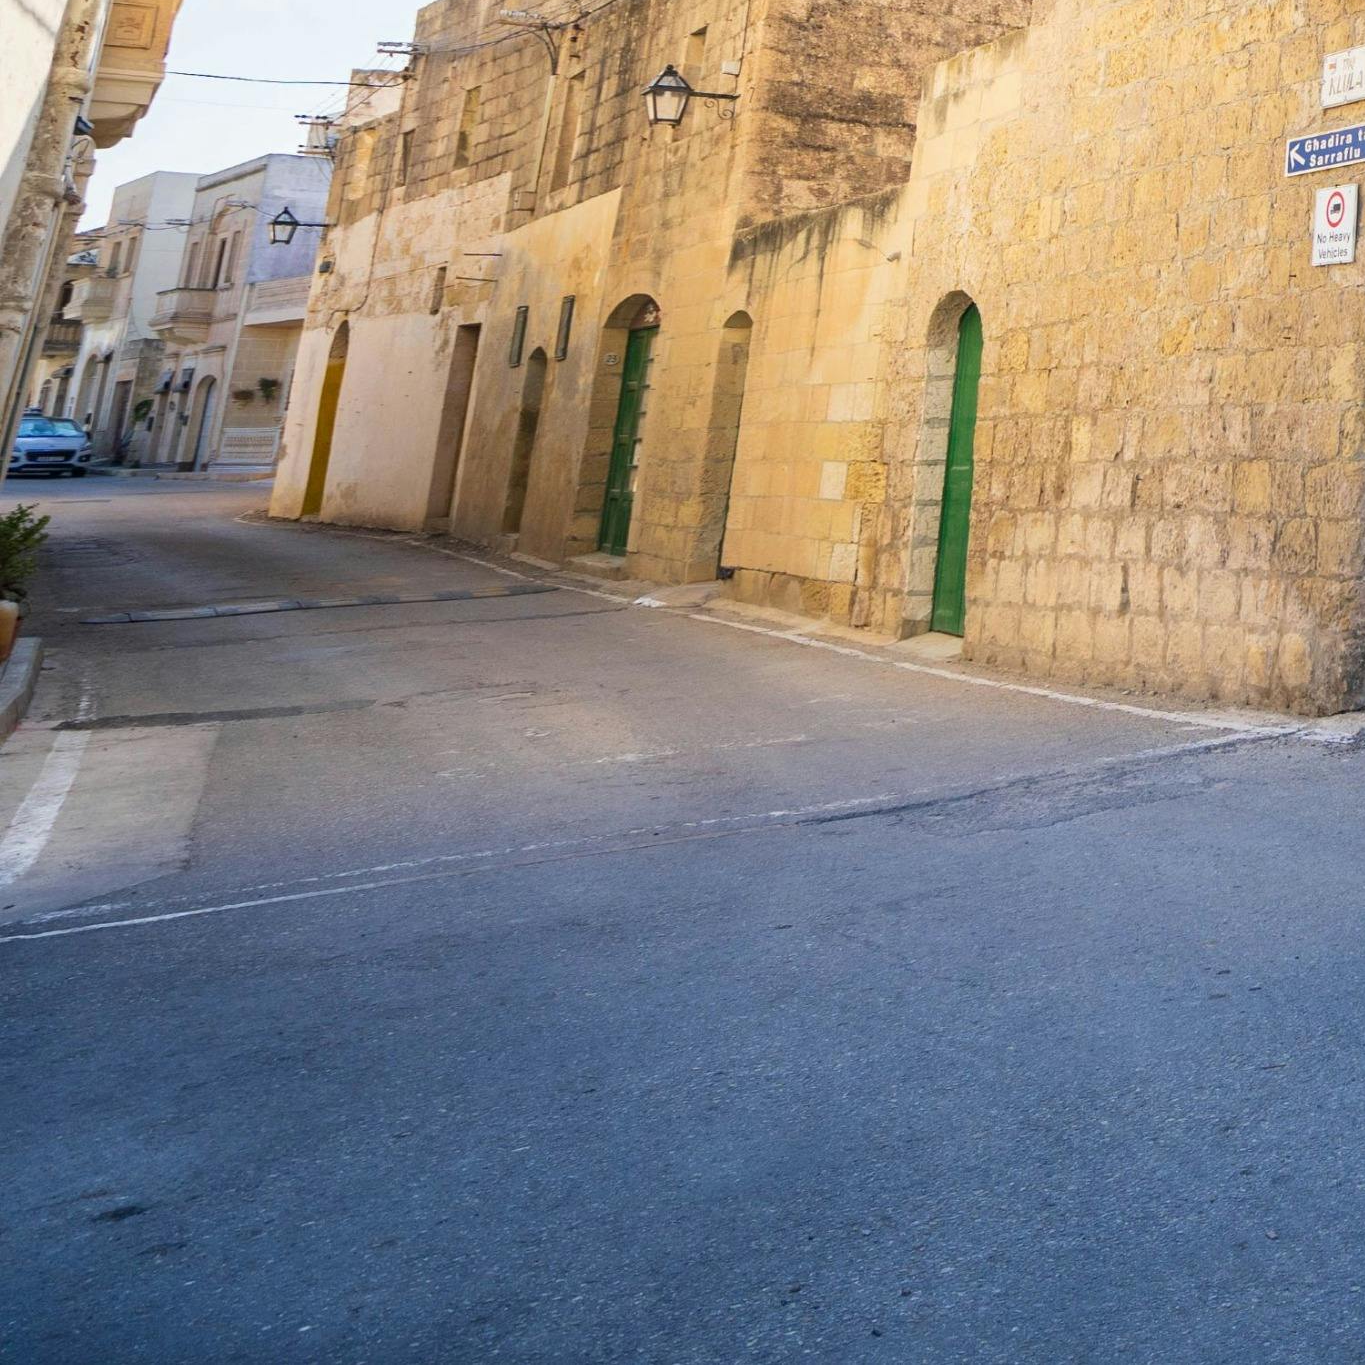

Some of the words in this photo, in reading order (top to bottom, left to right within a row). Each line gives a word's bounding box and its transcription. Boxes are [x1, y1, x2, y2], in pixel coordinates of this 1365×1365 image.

[1309, 146, 1361, 167] Sarraflu
[1317, 233, 1327, 244] No
[1329, 231, 1351, 244] Heavy
[1318, 247, 1348, 259] Vehicles
